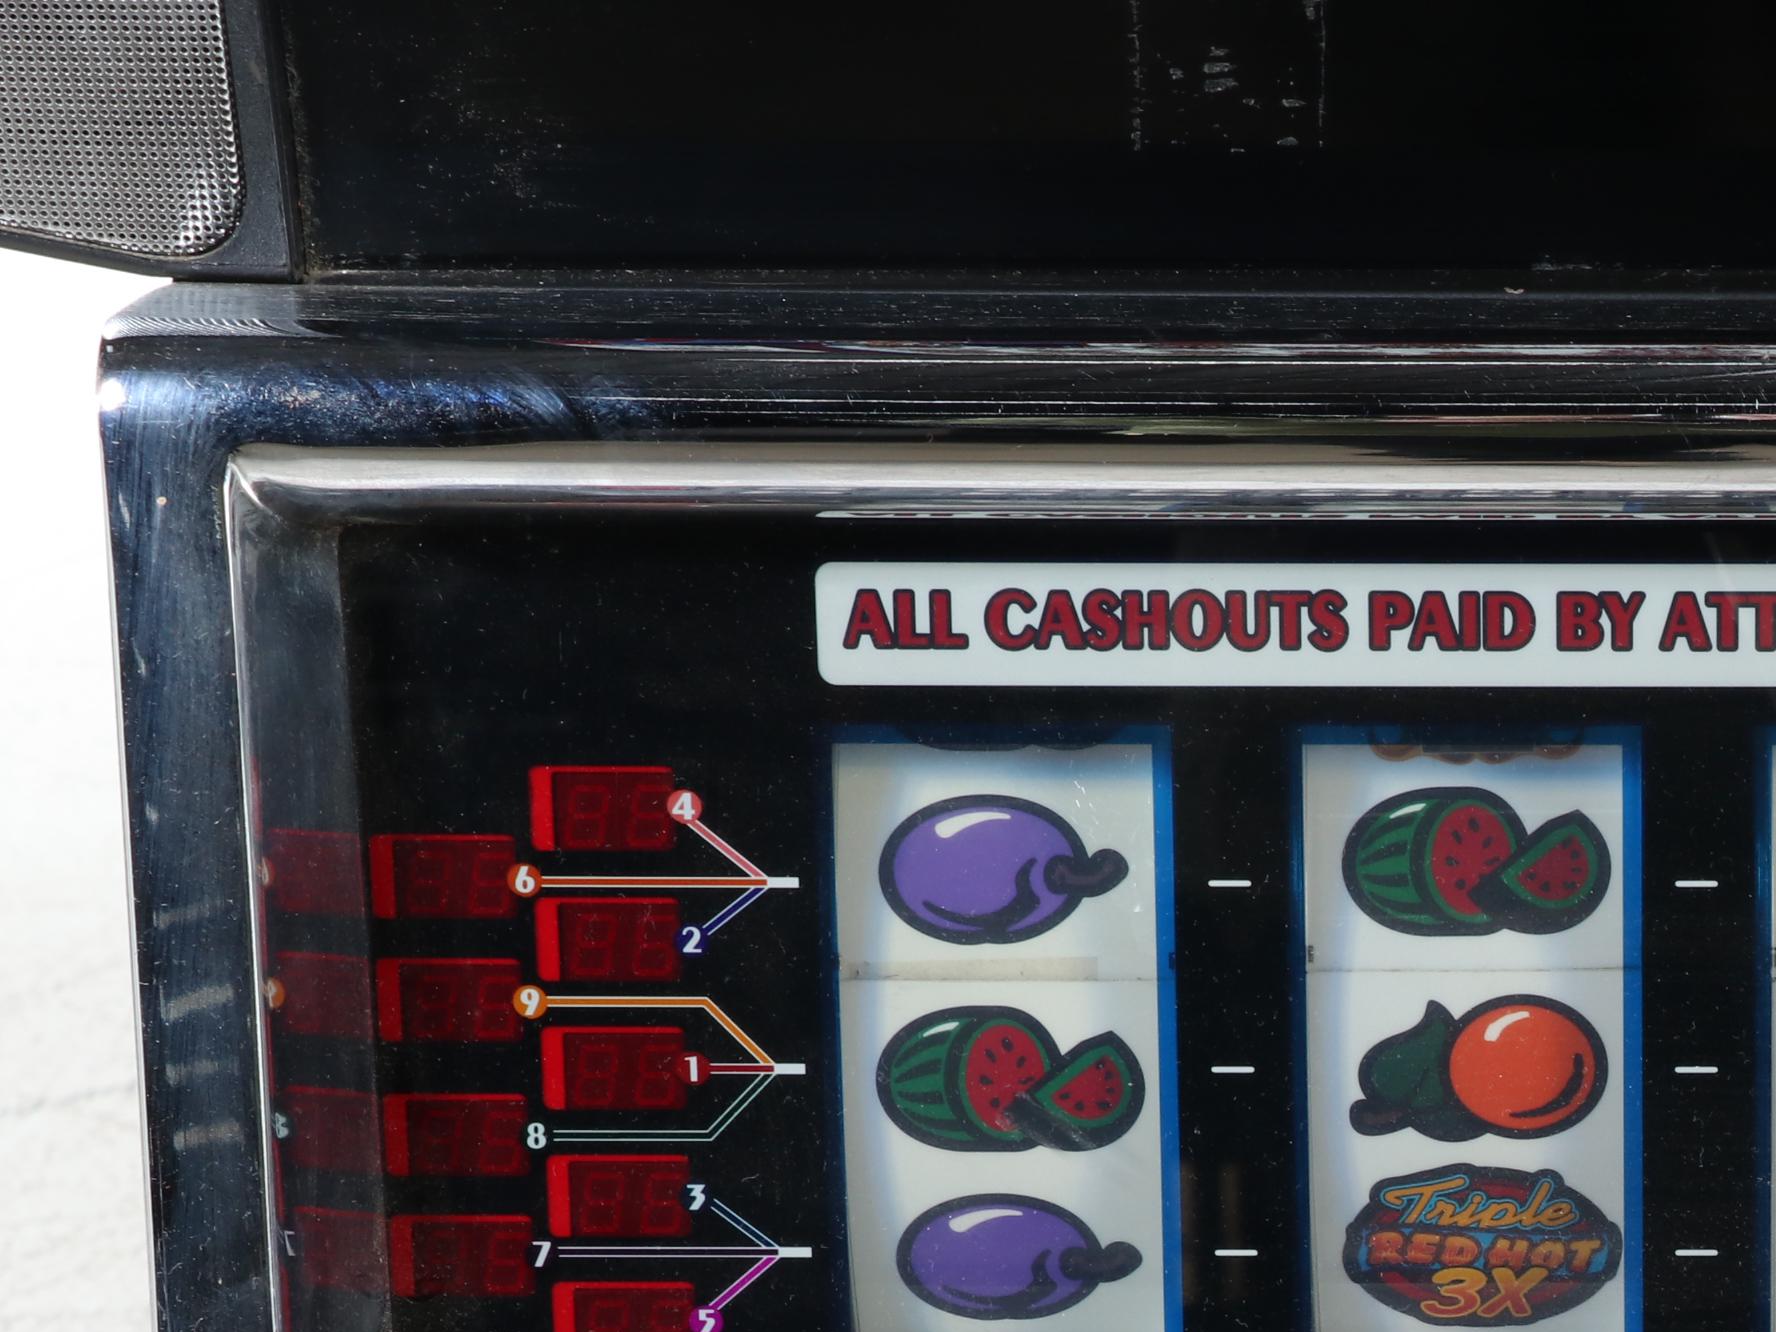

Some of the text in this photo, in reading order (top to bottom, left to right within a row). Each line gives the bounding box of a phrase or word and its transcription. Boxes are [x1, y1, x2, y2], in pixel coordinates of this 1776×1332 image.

[843, 589, 969, 649] ALL
[984, 588, 1348, 651] CASHOUTS
[1369, 590, 1536, 651] PAID
[1557, 591, 1646, 651] BY
[672, 792, 695, 820] 4
[515, 866, 535, 893] 6
[682, 926, 702, 953] 2
[520, 988, 540, 1015] 9
[684, 1056, 698, 1082] 1
[526, 1122, 547, 1149] 8
[686, 1184, 706, 1211] 3
[1380, 1174, 1579, 1230] Triple
[532, 1241, 551, 1267] 7
[1366, 1230, 1602, 1273] RED HOT
[1420, 1267, 1549, 1319] 3X
